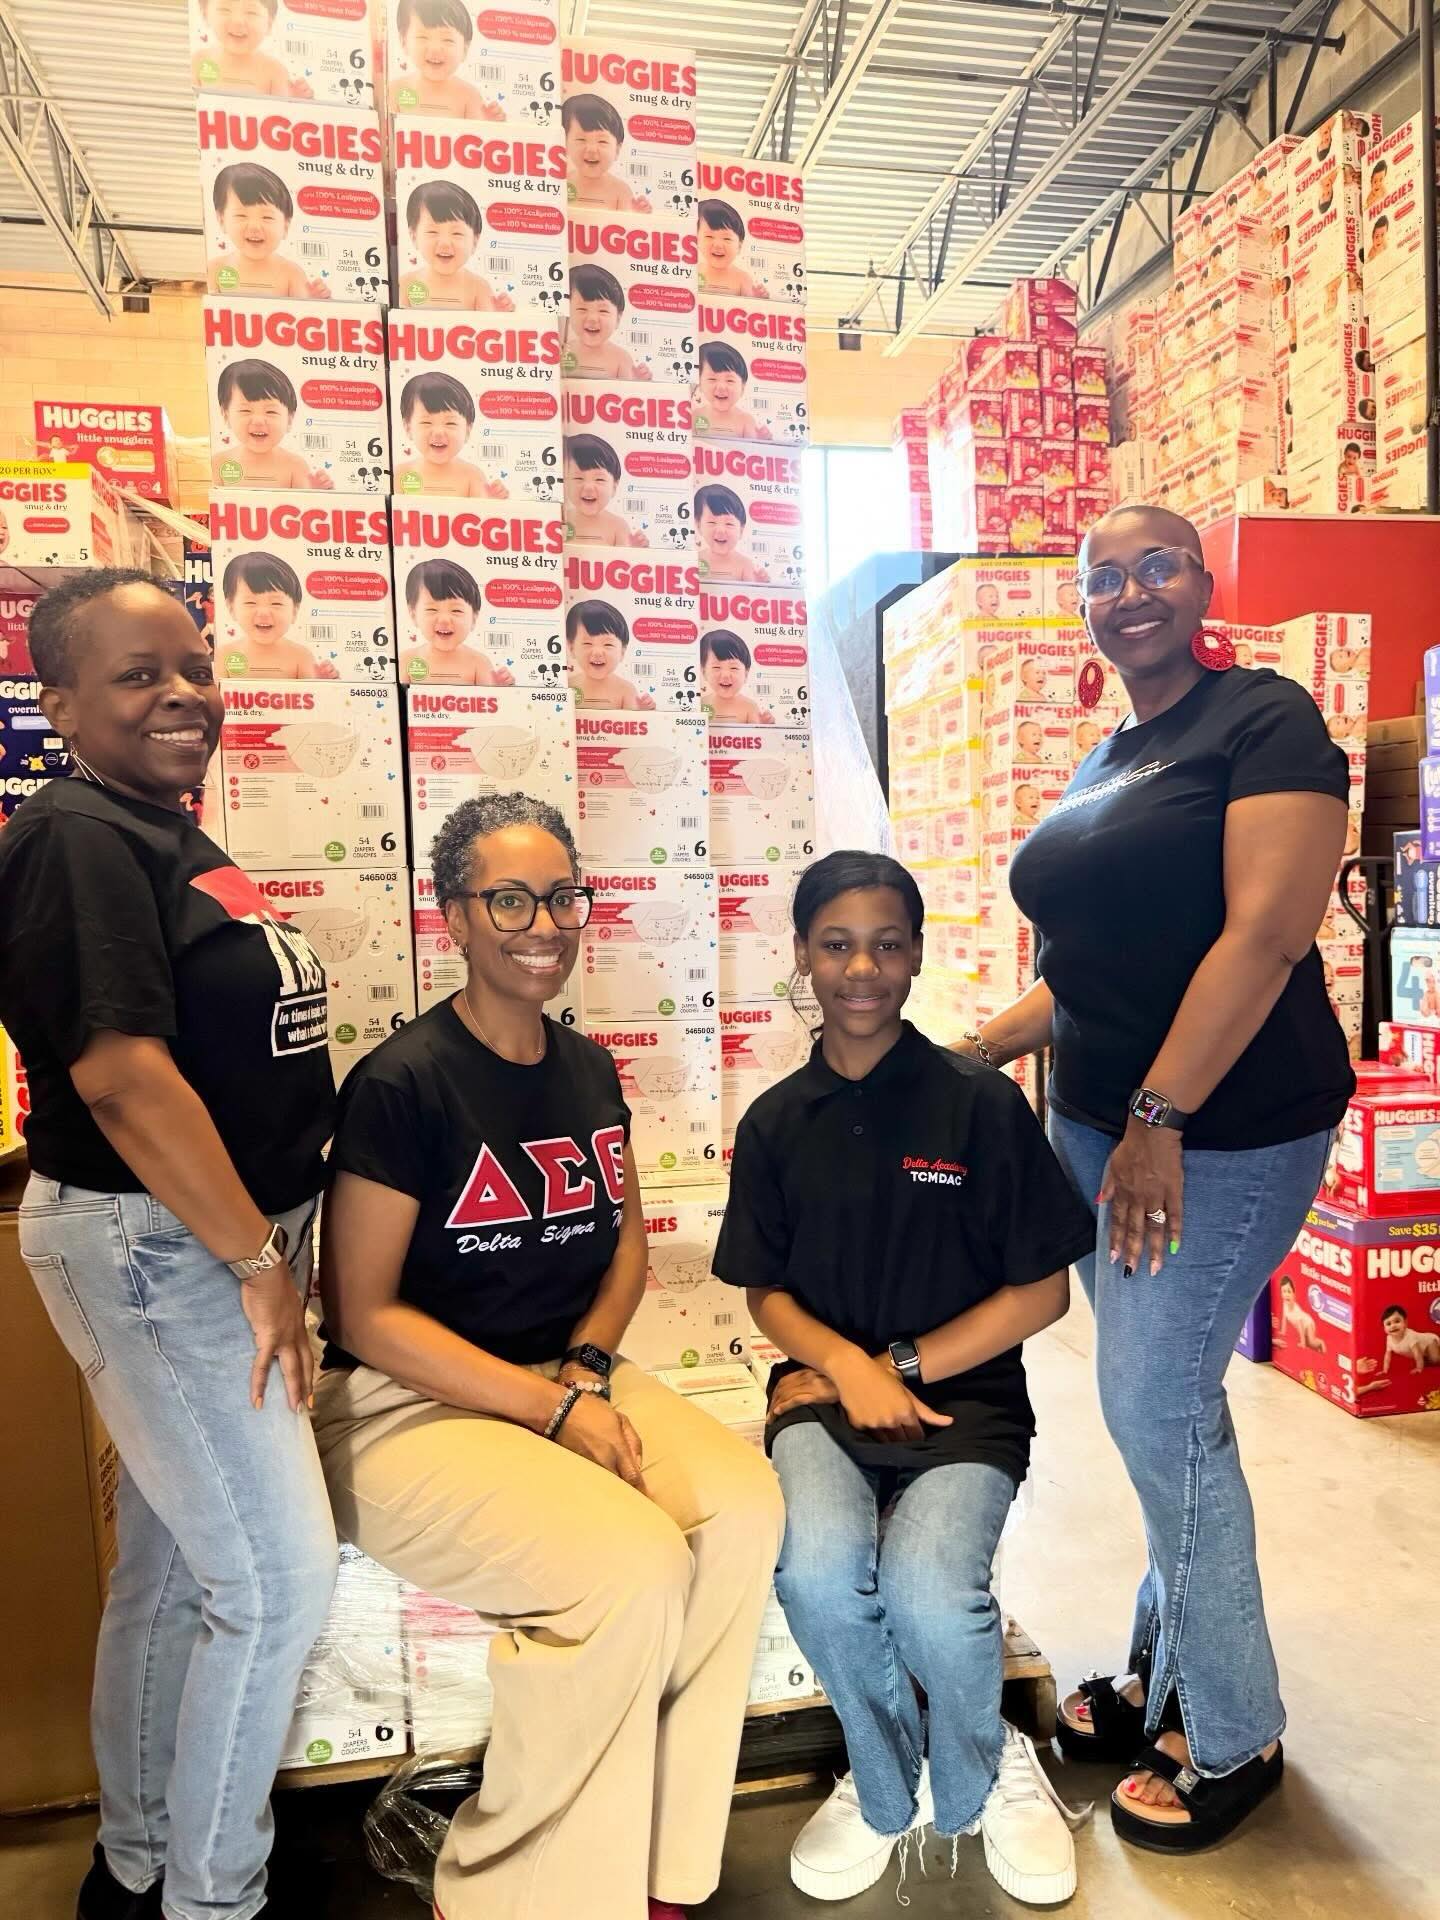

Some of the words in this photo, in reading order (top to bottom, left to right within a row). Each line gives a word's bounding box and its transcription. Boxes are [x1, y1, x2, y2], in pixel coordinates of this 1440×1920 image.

[349, 48, 365, 70] 6
[540, 71, 554, 92] 6
[629, 93, 658, 107] snug
[672, 97, 692, 109] dry
[199, 110, 382, 163] HUGGIES
[1367, 122, 1412, 165] HUGGIES
[396, 131, 568, 179] HUGGIES
[298, 160, 332, 175] snug
[350, 166, 374, 179] dry
[488, 177, 521, 191] snug
[537, 181, 561, 195] dry
[681, 170, 693, 186] 6
[697, 162, 803, 201] UGGIES
[749, 200, 772, 210] snug
[784, 203, 799, 213] dry
[1369, 179, 1413, 220] HUGGIES
[568, 221, 698, 265] UGGIES
[1345, 217, 1355, 272] HUGGIES
[364, 247, 381, 267] 6
[528, 264, 538, 272] 54
[549, 261, 563, 281] 6
[630, 263, 658, 275] snug
[672, 266, 692, 278] dry
[793, 263, 803, 277] 6
[204, 309, 384, 356] HUGGIES
[389, 324, 561, 364] HUGGIES
[681, 337, 693, 353] 6
[752, 340, 775, 351] snug
[787, 343, 802, 352] dry
[1344, 324, 1353, 371] HUGGIES
[302, 353, 336, 368] snug
[354, 357, 378, 371] dry
[481, 366, 513, 379] snug
[529, 368, 553, 381] dry
[566, 391, 692, 430] UGGIES
[796, 402, 806, 417] 6
[43, 406, 152, 432] HUGGIES
[77, 433, 102, 442] little
[104, 435, 153, 446] snugglers
[345, 441, 356, 449] 54
[626, 431, 654, 442] snug
[667, 433, 687, 444] dry
[367, 437, 382, 458] 6
[520, 450, 531, 458] 54
[542, 447, 556, 467] 6
[153, 482, 161, 494] 4
[750, 484, 773, 493] snug
[678, 502, 690, 519] 6
[210, 503, 389, 545] HUGGIES
[392, 510, 563, 553] HUGGIES
[80, 548, 88, 560] 5
[306, 547, 341, 560] snug
[358, 548, 382, 561] dry
[486, 555, 519, 569] snug
[535, 556, 557, 570] dry
[976, 570, 1030, 582] HUGGIES
[634, 597, 662, 608] snug
[676, 596, 695, 610] dry
[351, 631, 362, 639] 54
[373, 626, 389, 647] 6
[754, 626, 777, 637] snug
[788, 628, 804, 637] dry
[1226, 628, 1285, 643] HUGGIES
[527, 639, 538, 647] 54
[547, 635, 562, 654] 6
[1018, 643, 1075, 656] HUGGIES
[1314, 614, 1327, 674] HUGGIES
[684, 666, 696, 682] 6
[224, 692, 315, 710] HUGGIES
[797, 686, 807, 700] 6
[8, 705, 42, 714] overni
[413, 695, 498, 714] HUGGIES
[576, 719, 648, 736] HUGGIES
[60, 753, 69, 765] 7
[380, 832, 396, 852] 6
[695, 841, 706, 856] 6
[803, 840, 813, 854] 6
[586, 875, 656, 891] HUGGIES
[1396, 962, 1424, 1010] 4
[703, 991, 714, 1007] 6
[391, 1012, 405, 1030] 6
[561, 1007, 575, 1025] 6
[1375, 1110, 1435, 1125] HUGGIES
[704, 1144, 715, 1159] 6
[903, 1157, 929, 1169] Delta
[910, 1171, 961, 1186] TCMDAC
[456, 1233, 522, 1253] Delta
[540, 1222, 595, 1245] Sigma
[1388, 1227, 1411, 1236] Save
[1413, 1223, 1437, 1237] $35
[730, 1338, 742, 1355] 6
[1341, 1374, 1354, 1403] 3
[788, 1664, 804, 1686] 6
[348, 1728, 361, 1738] 54
[341, 1746, 370, 1755] COUCHES
[343, 1739, 368, 1748] DIAPERS
